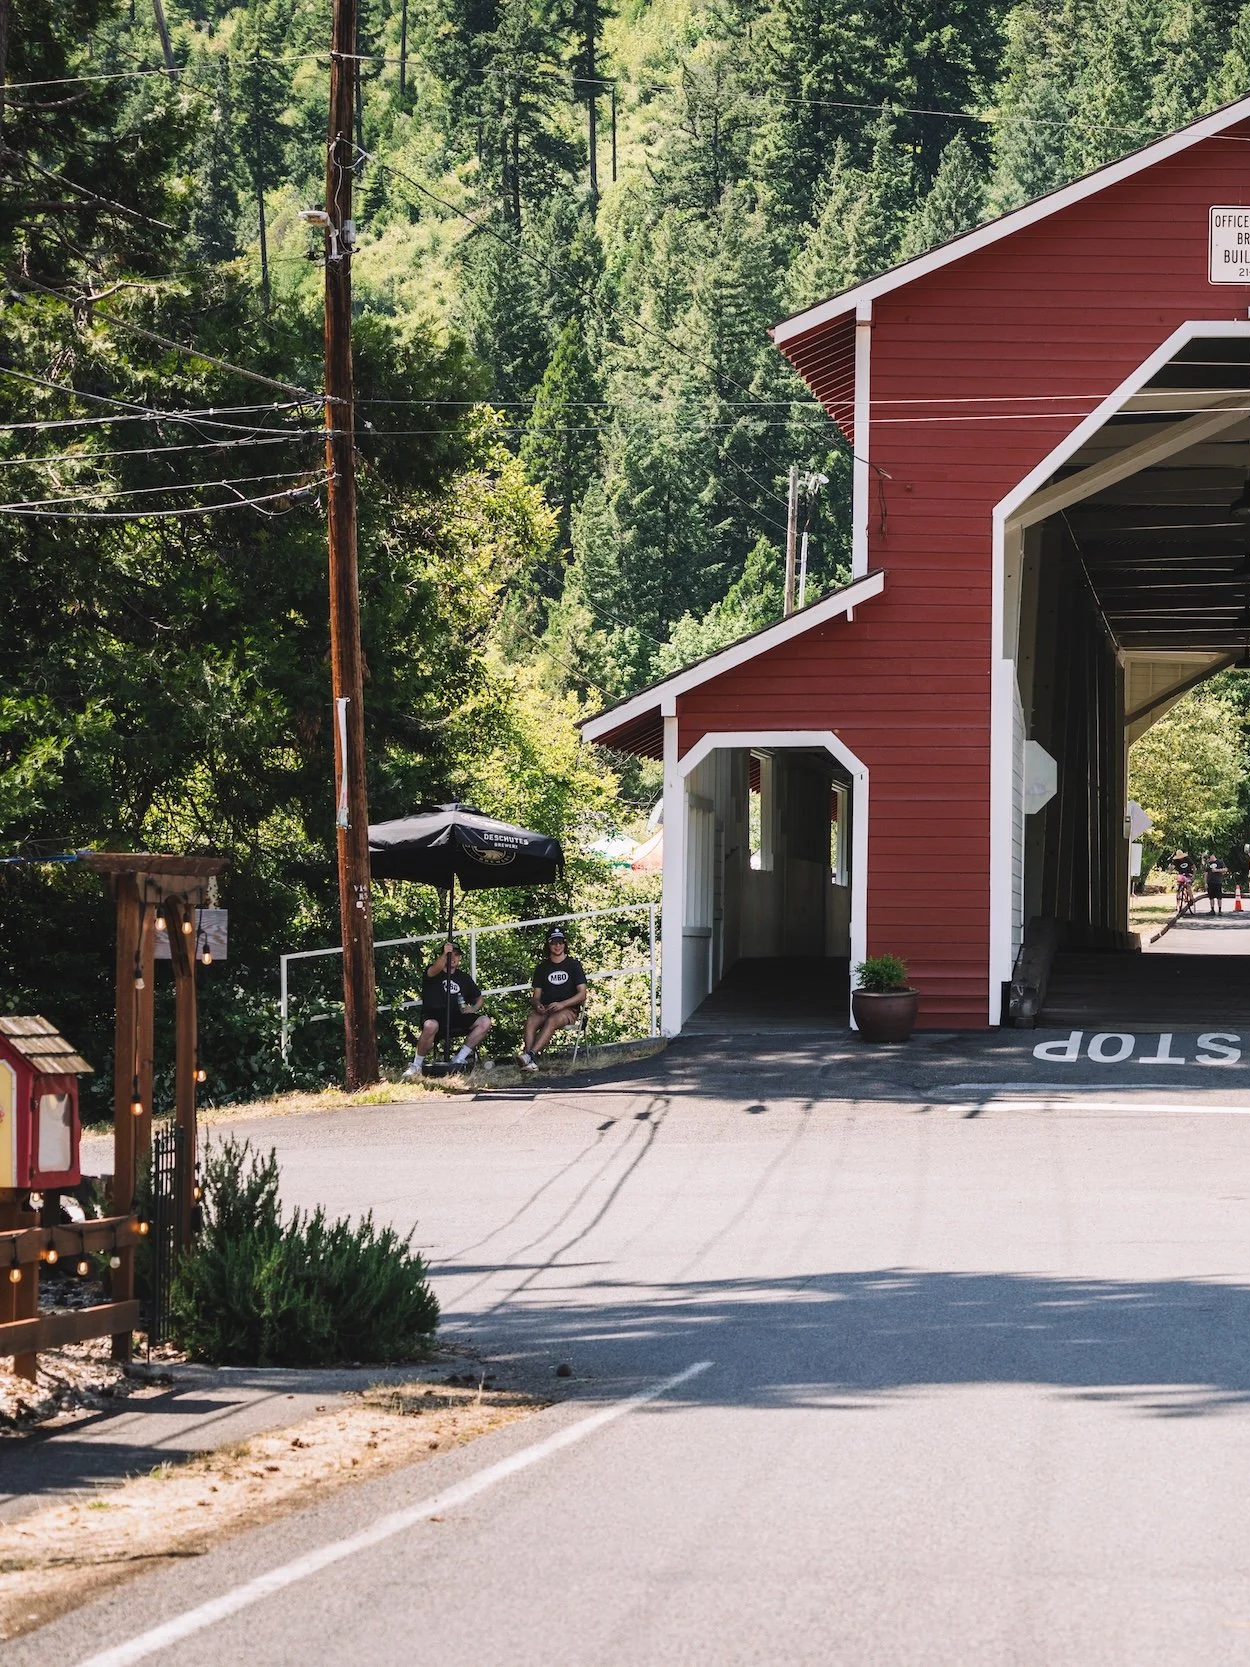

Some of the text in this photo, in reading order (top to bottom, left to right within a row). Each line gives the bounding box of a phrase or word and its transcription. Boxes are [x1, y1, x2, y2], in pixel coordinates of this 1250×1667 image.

[1214, 215, 1249, 228] OFFICE
[483, 833, 529, 846] DESCHUTES
[550, 973, 567, 982] MBO
[1032, 1030, 1242, 1066] STOP
